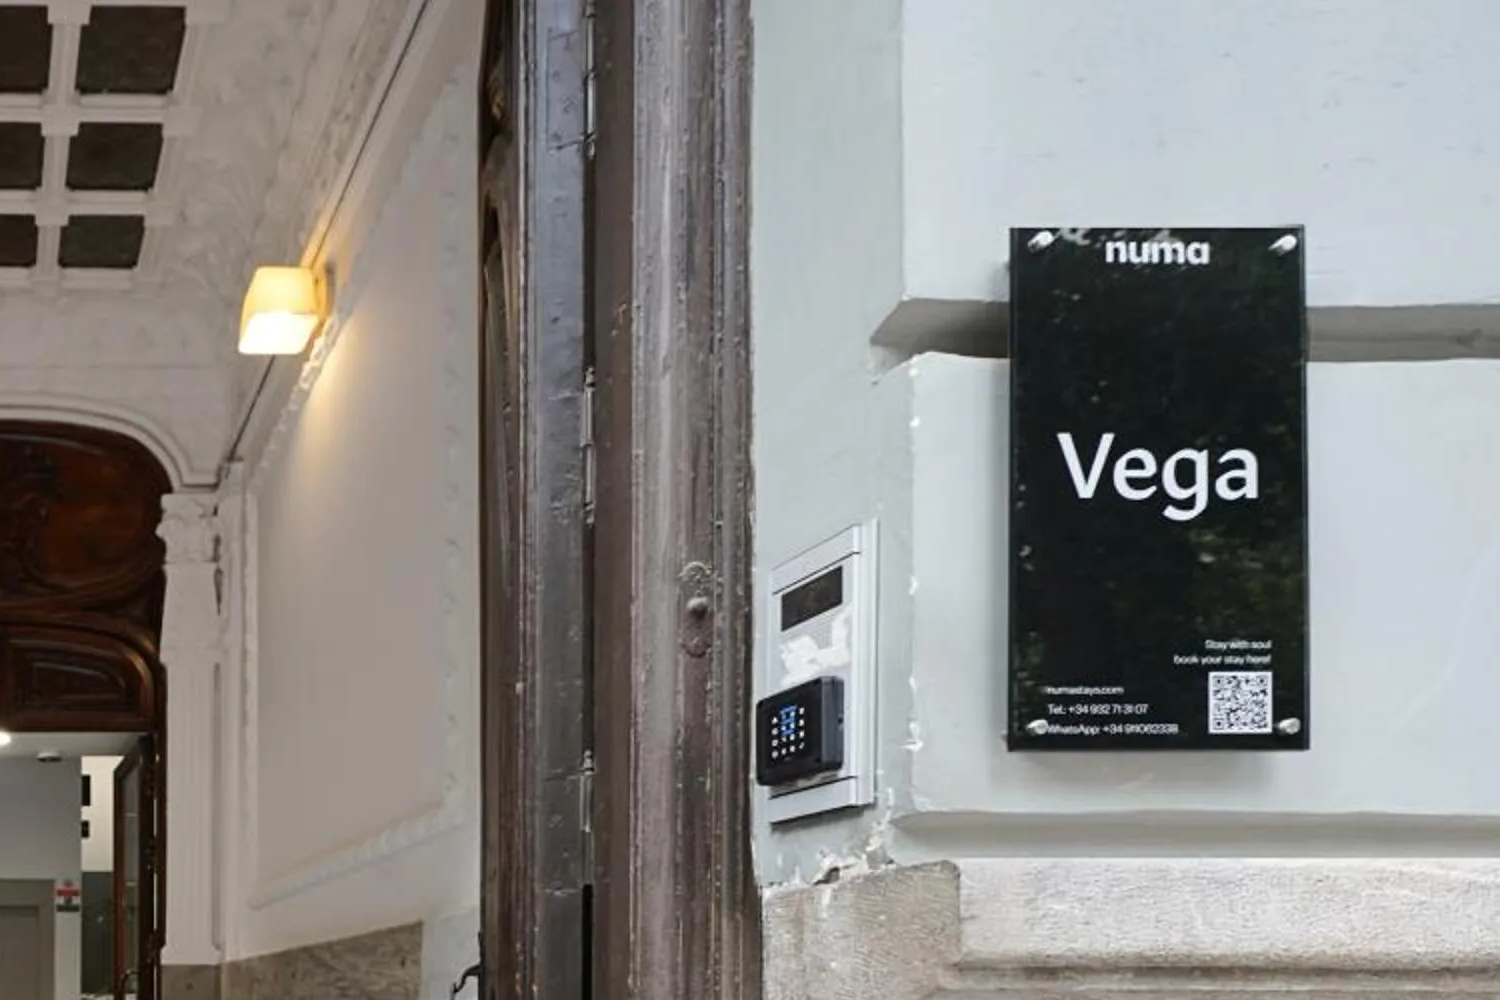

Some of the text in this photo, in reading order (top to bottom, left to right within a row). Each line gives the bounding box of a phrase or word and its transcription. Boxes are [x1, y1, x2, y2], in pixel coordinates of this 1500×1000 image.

[1105, 240, 1211, 265] numa
[1056, 431, 1259, 521] Vega
[1173, 654, 1199, 665] book
[1201, 656, 1222, 666] your
[1068, 703, 1089, 715] +34
[1134, 703, 1149, 715] 07
[1102, 723, 1124, 735] +34
